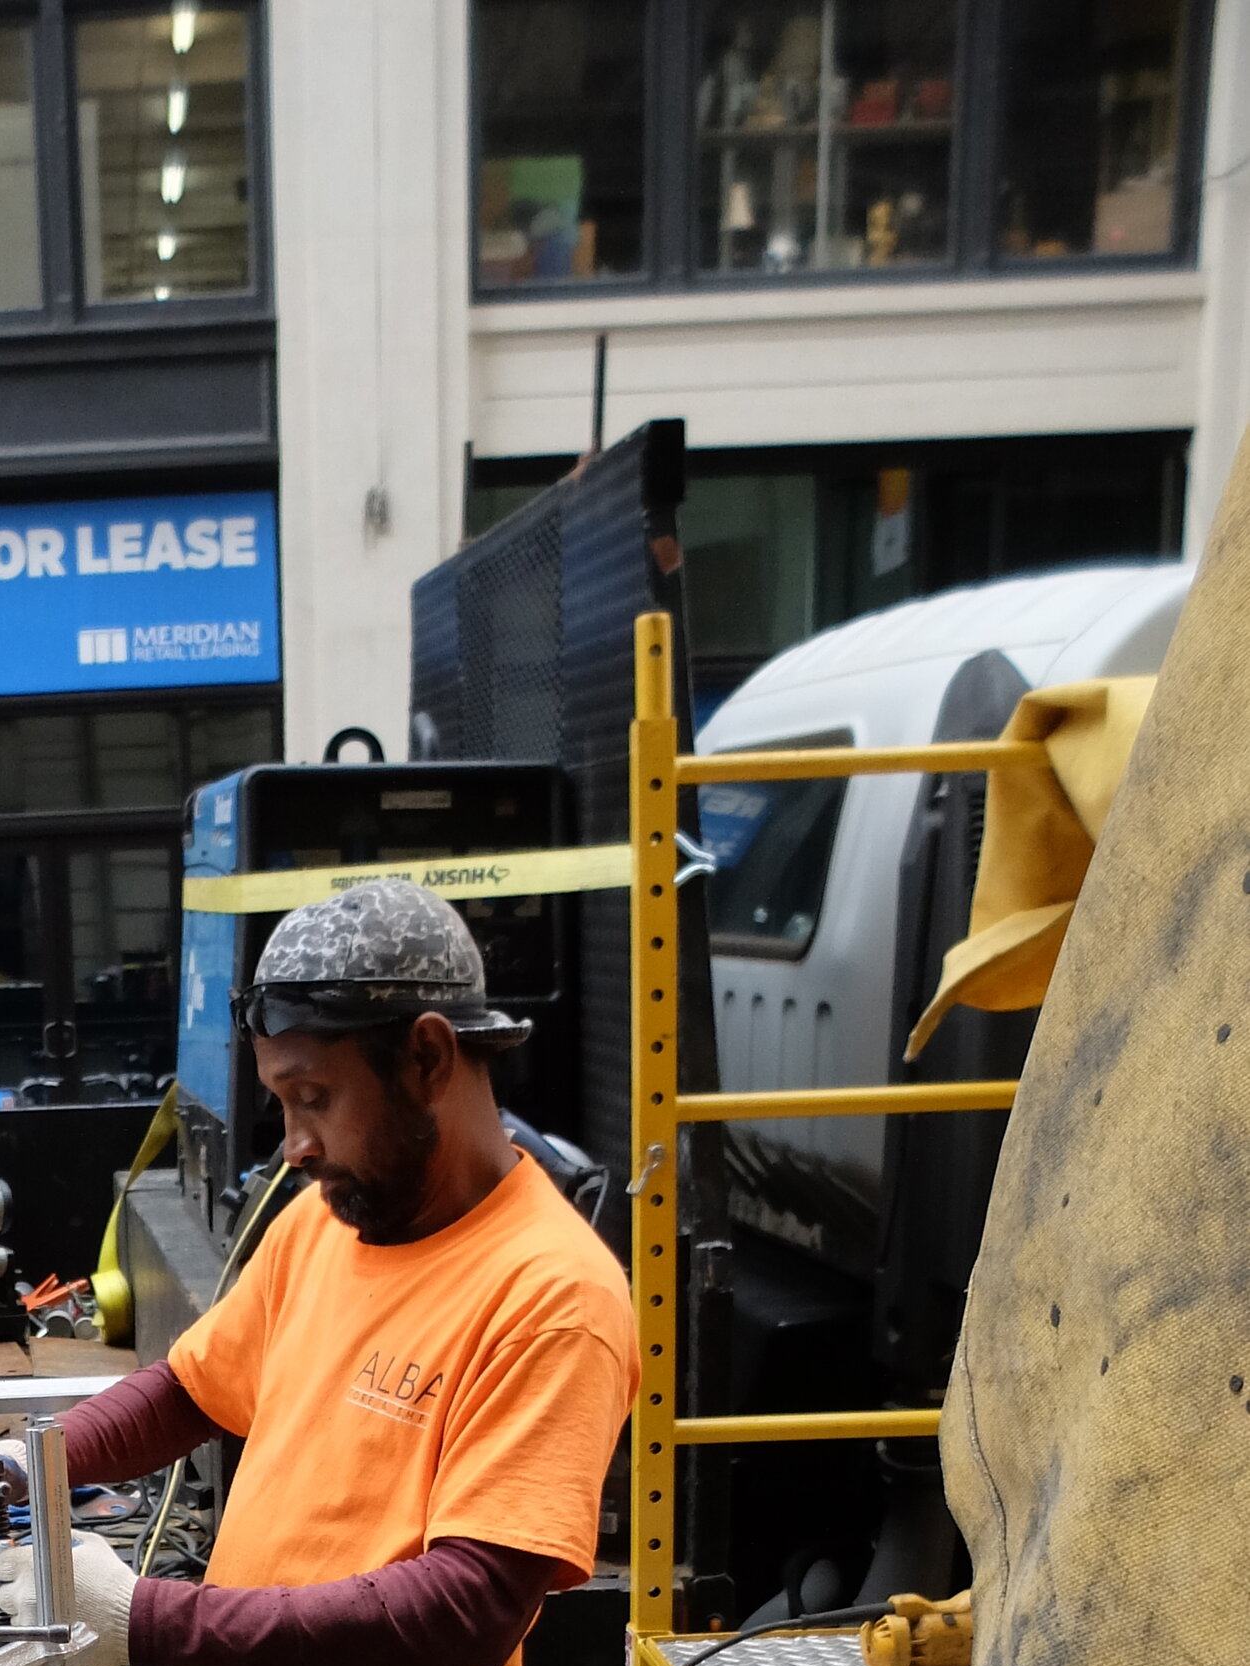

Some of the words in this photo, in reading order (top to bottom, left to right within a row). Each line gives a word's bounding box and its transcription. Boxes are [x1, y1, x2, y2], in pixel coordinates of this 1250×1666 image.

[76, 517, 256, 574] LEASE
[133, 621, 259, 645] MERIDIAN
[134, 646, 183, 660] RETAIL
[191, 643, 258, 658] LEASING
[421, 868, 484, 886] HUSKY
[354, 1350, 443, 1405] ALBA
